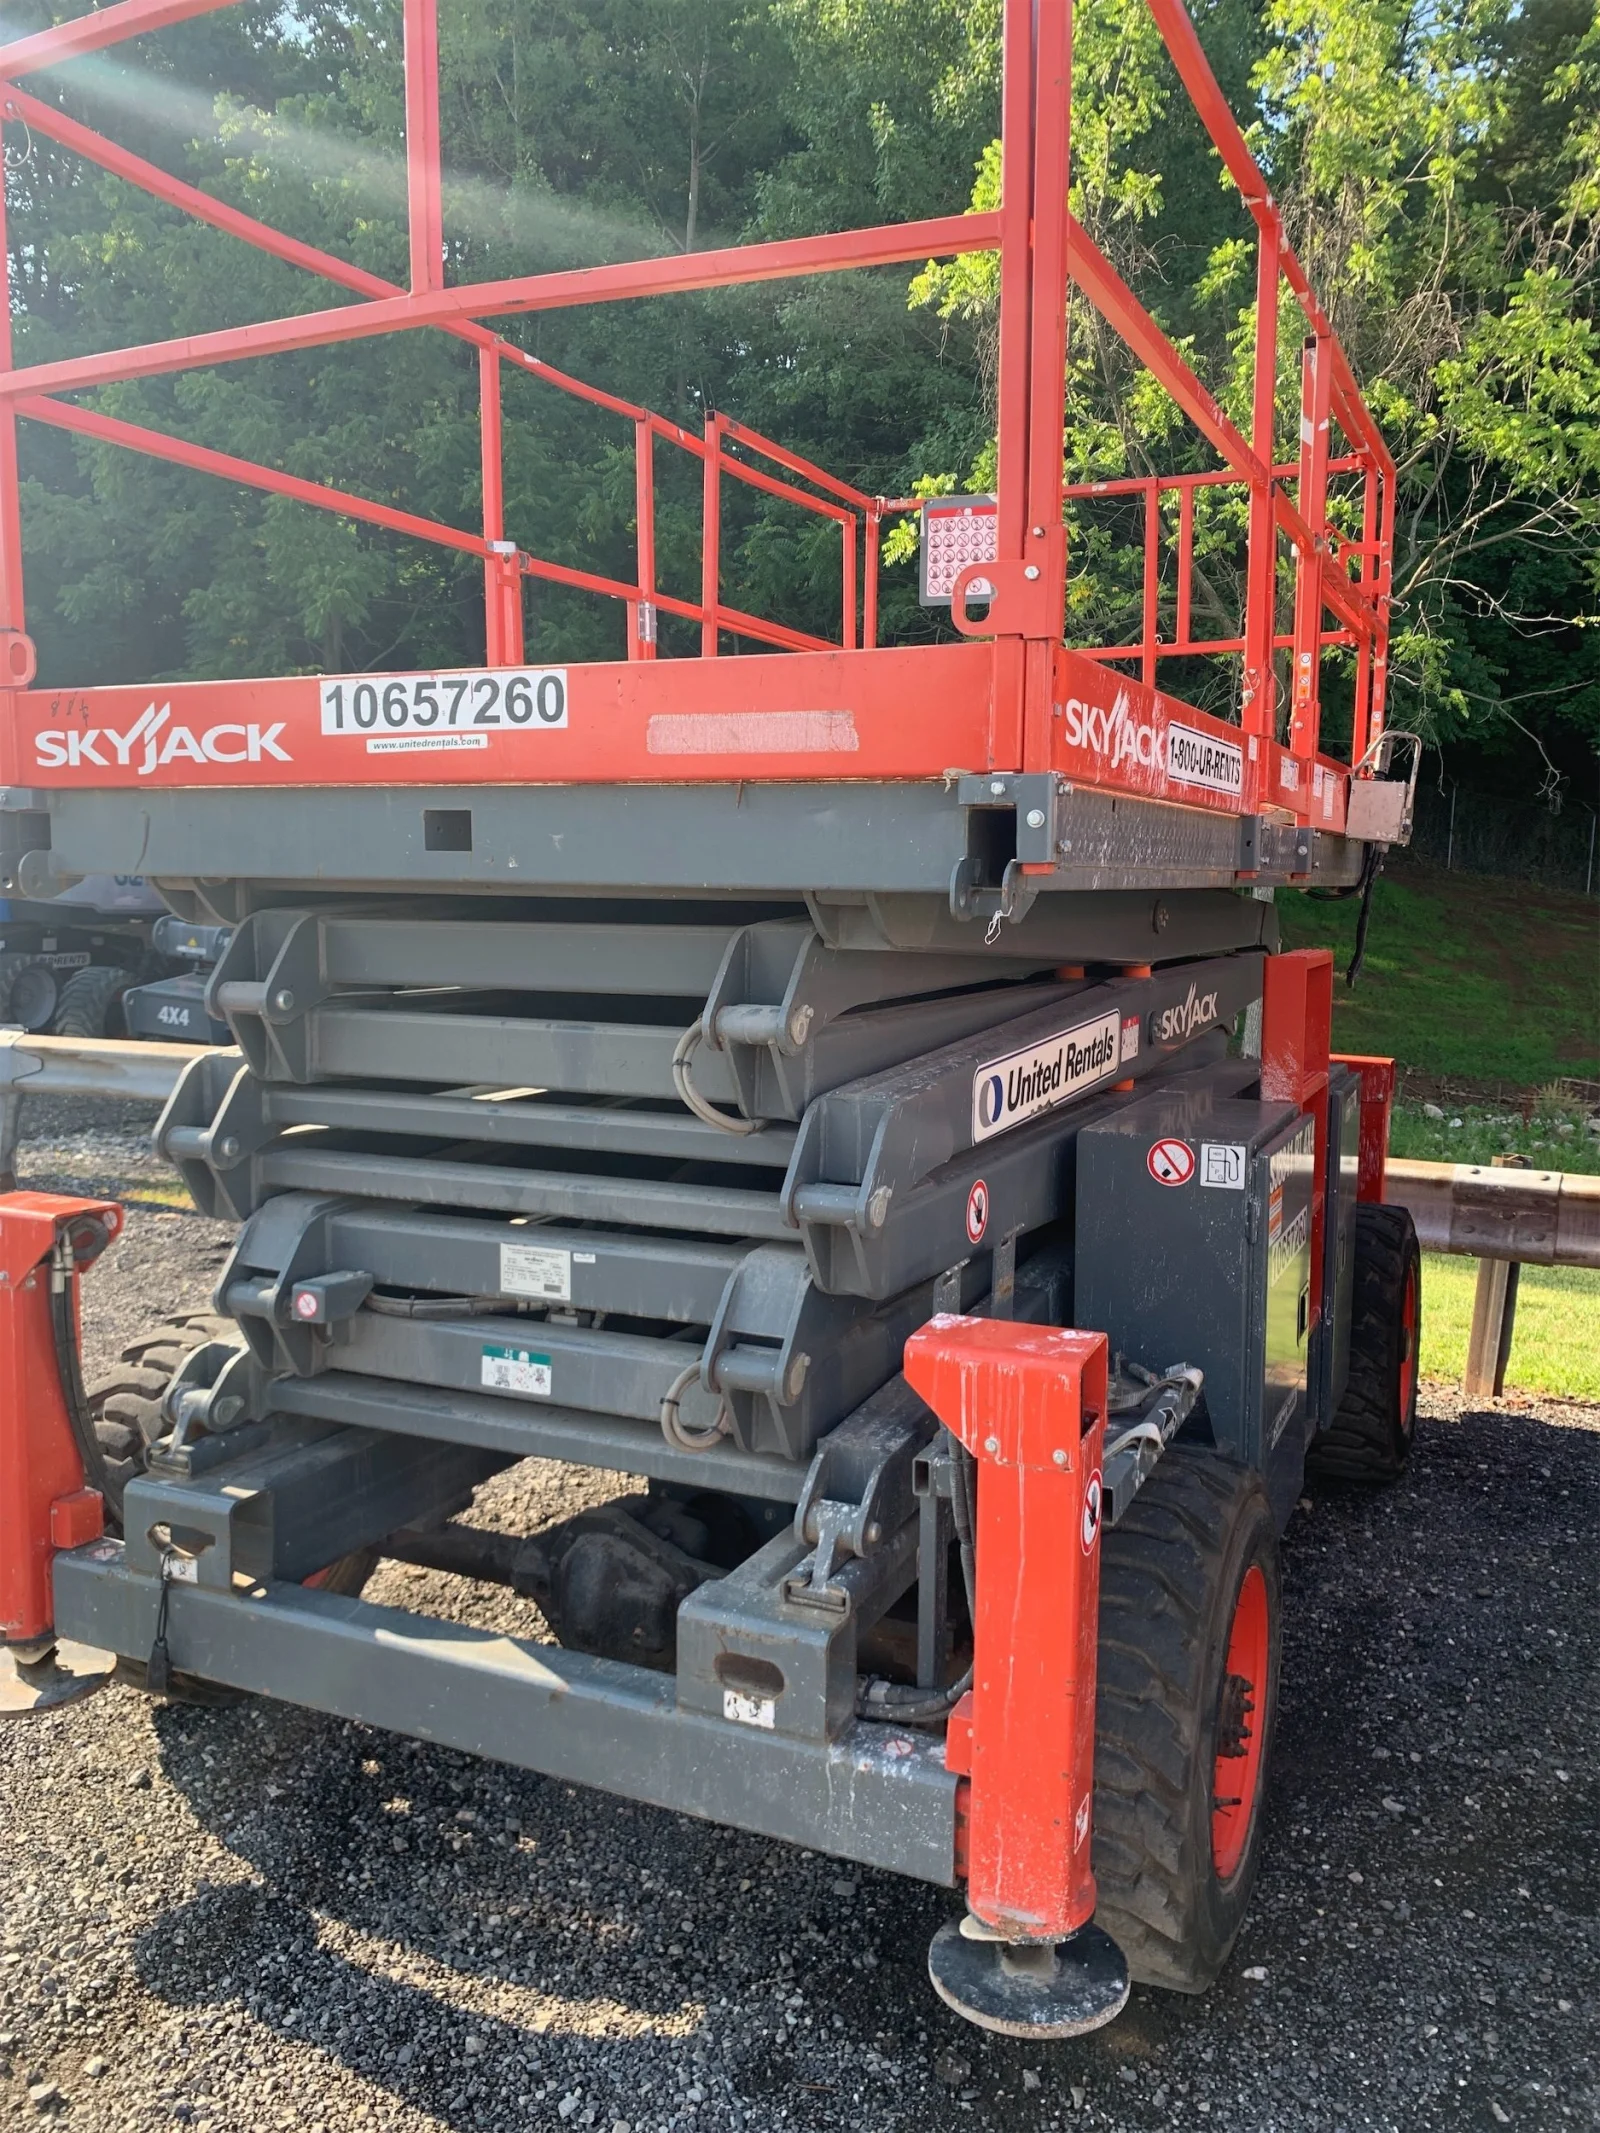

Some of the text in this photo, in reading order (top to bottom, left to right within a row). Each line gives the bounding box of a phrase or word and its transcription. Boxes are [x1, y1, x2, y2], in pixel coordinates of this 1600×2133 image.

[326, 675, 565, 729] 10657260
[1065, 689, 1165, 769] SKYJACK
[35, 701, 294, 775] SKYJACK
[373, 736, 481, 750] www.unitedrentals.com
[1170, 735, 1241, 785] 1-800-UR-RENTS
[1161, 982, 1218, 1040] SKYJACK
[1007, 1048, 1063, 1112] United
[1065, 1026, 1114, 1083] Rentals
